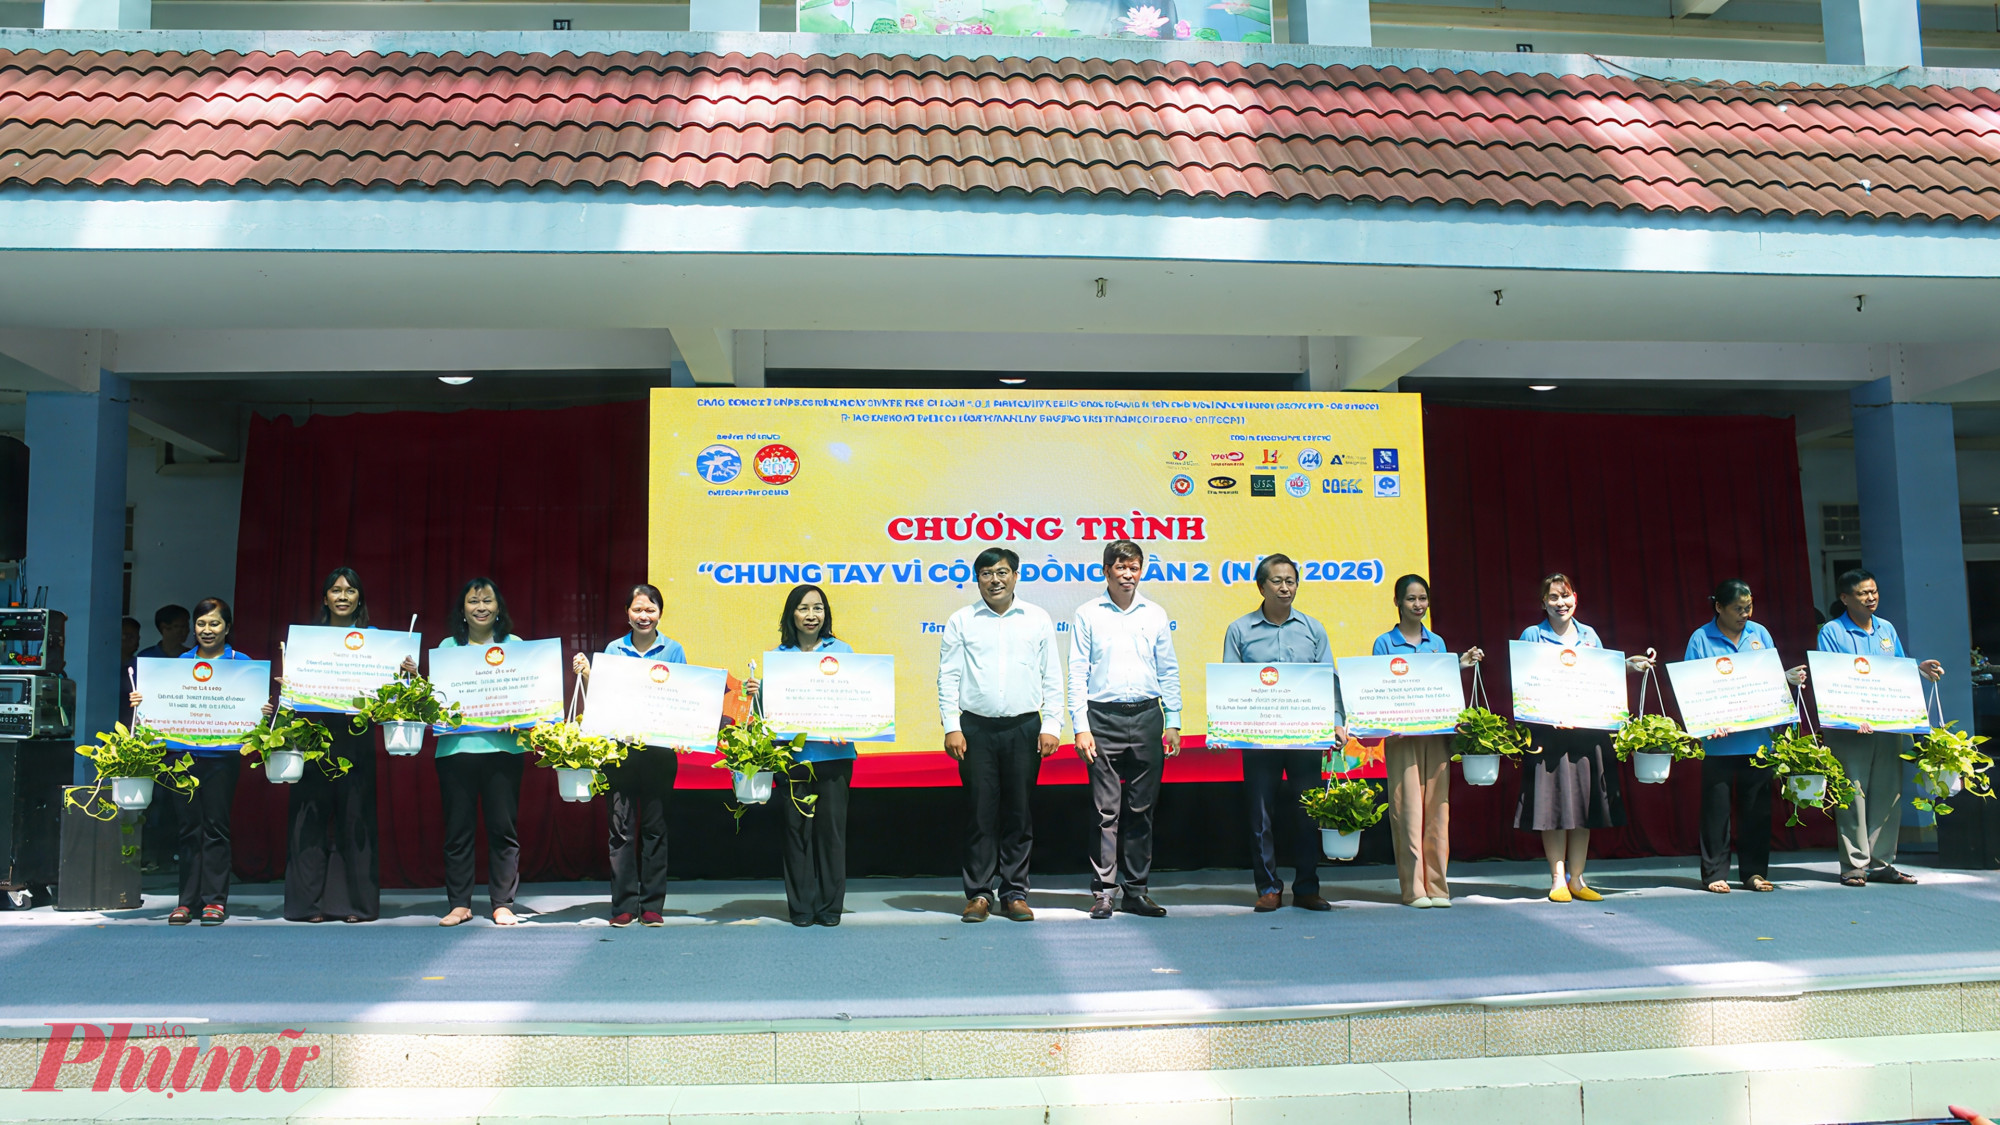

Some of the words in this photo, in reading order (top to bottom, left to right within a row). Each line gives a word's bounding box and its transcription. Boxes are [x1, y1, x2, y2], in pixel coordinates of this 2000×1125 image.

[887, 512, 1064, 541] CHƯƠNG
[1076, 510, 1205, 541] TRÌNH
[827, 563, 886, 584] TAY
[891, 558, 923, 583] VÌ
[1020, 553, 1106, 583] ĐỒNG
[1138, 553, 1187, 582] ẦN
[1192, 562, 1210, 582] 2
[1304, 559, 1384, 584] 2026)
